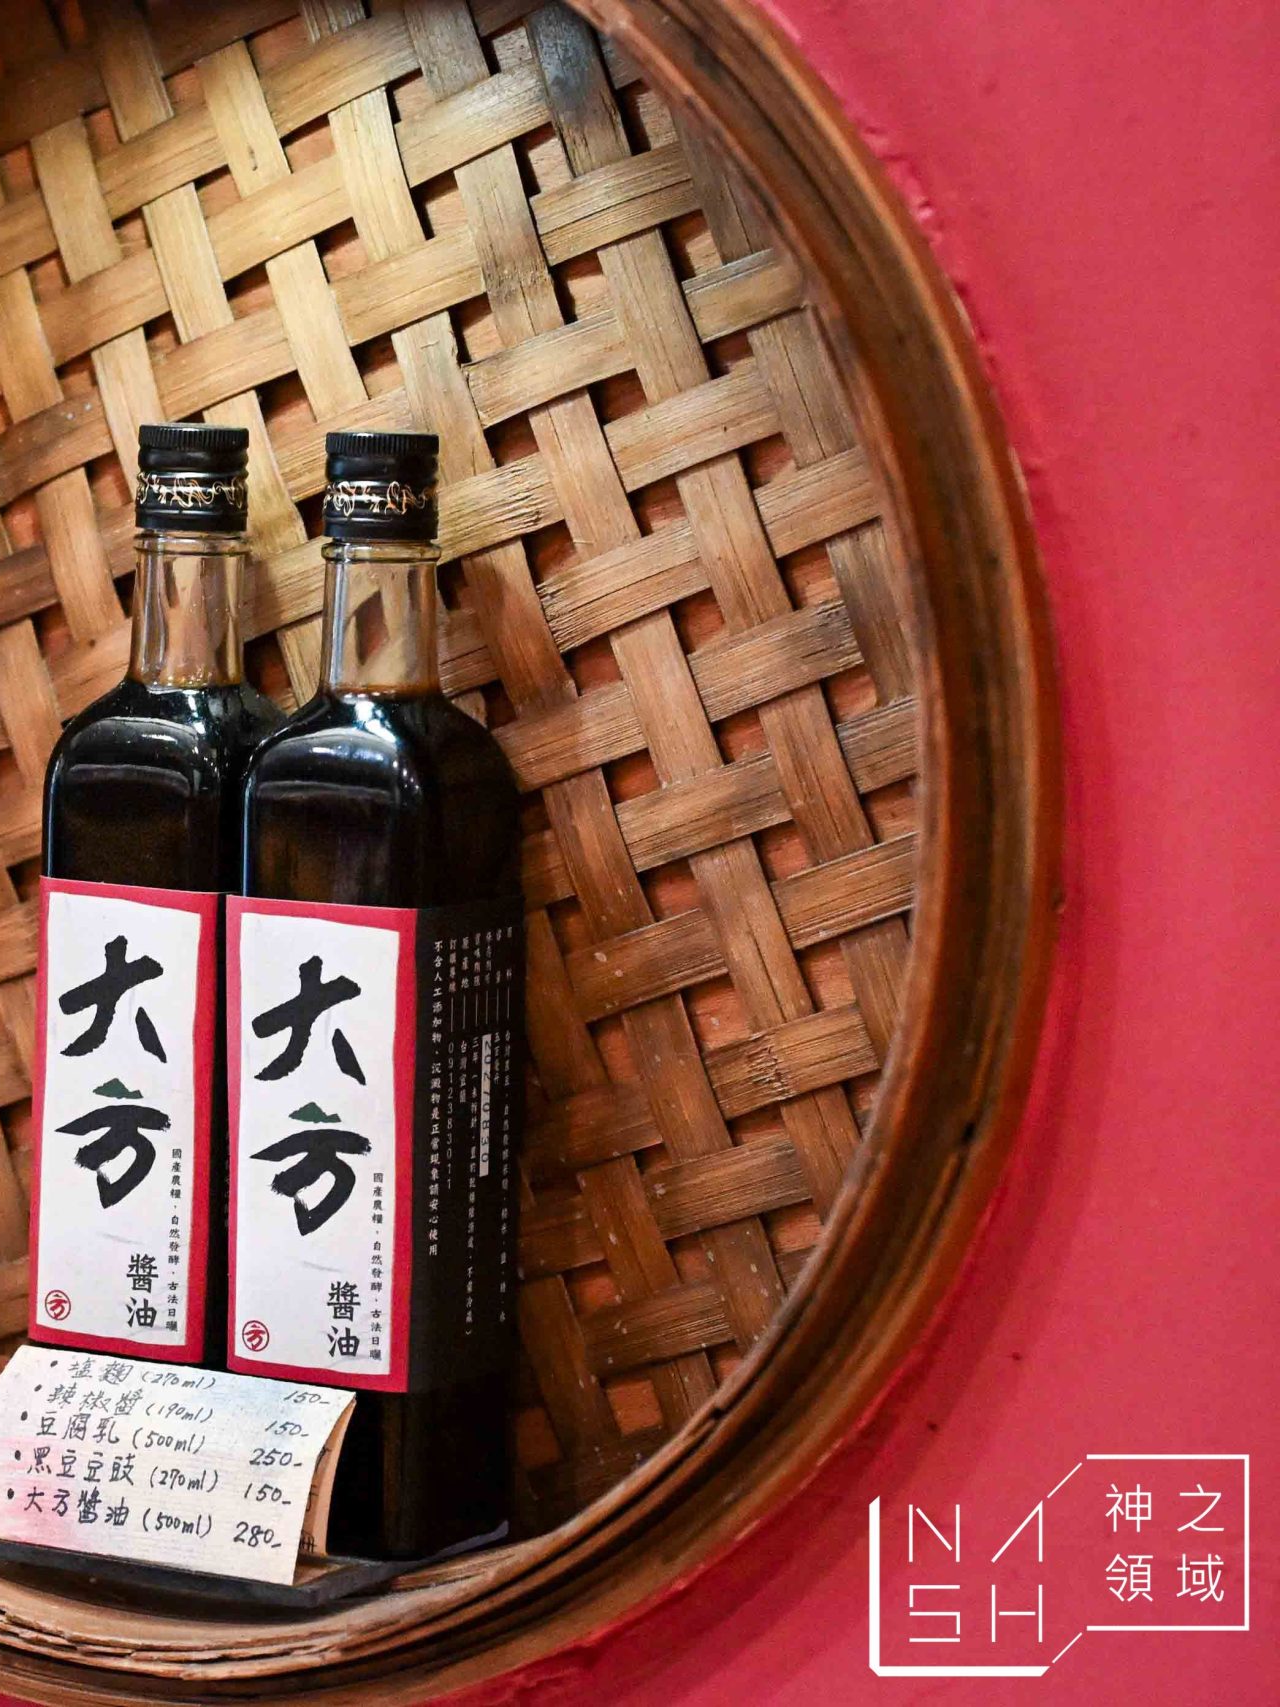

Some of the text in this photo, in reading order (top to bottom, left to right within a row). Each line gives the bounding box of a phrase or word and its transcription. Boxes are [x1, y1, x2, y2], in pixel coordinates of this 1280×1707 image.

[54, 935, 171, 1210] 大方
[250, 955, 372, 1236] 大方
[125, 1252, 158, 1329] 醬油
[327, 1280, 361, 1358] 醬油
[36, 1411, 120, 1444] 豆腐乳
[47, 1382, 144, 1416] 辣椒醬
[27, 1446, 135, 1486] 黑豆豆豉
[24, 1486, 130, 1526] 大方醬油
